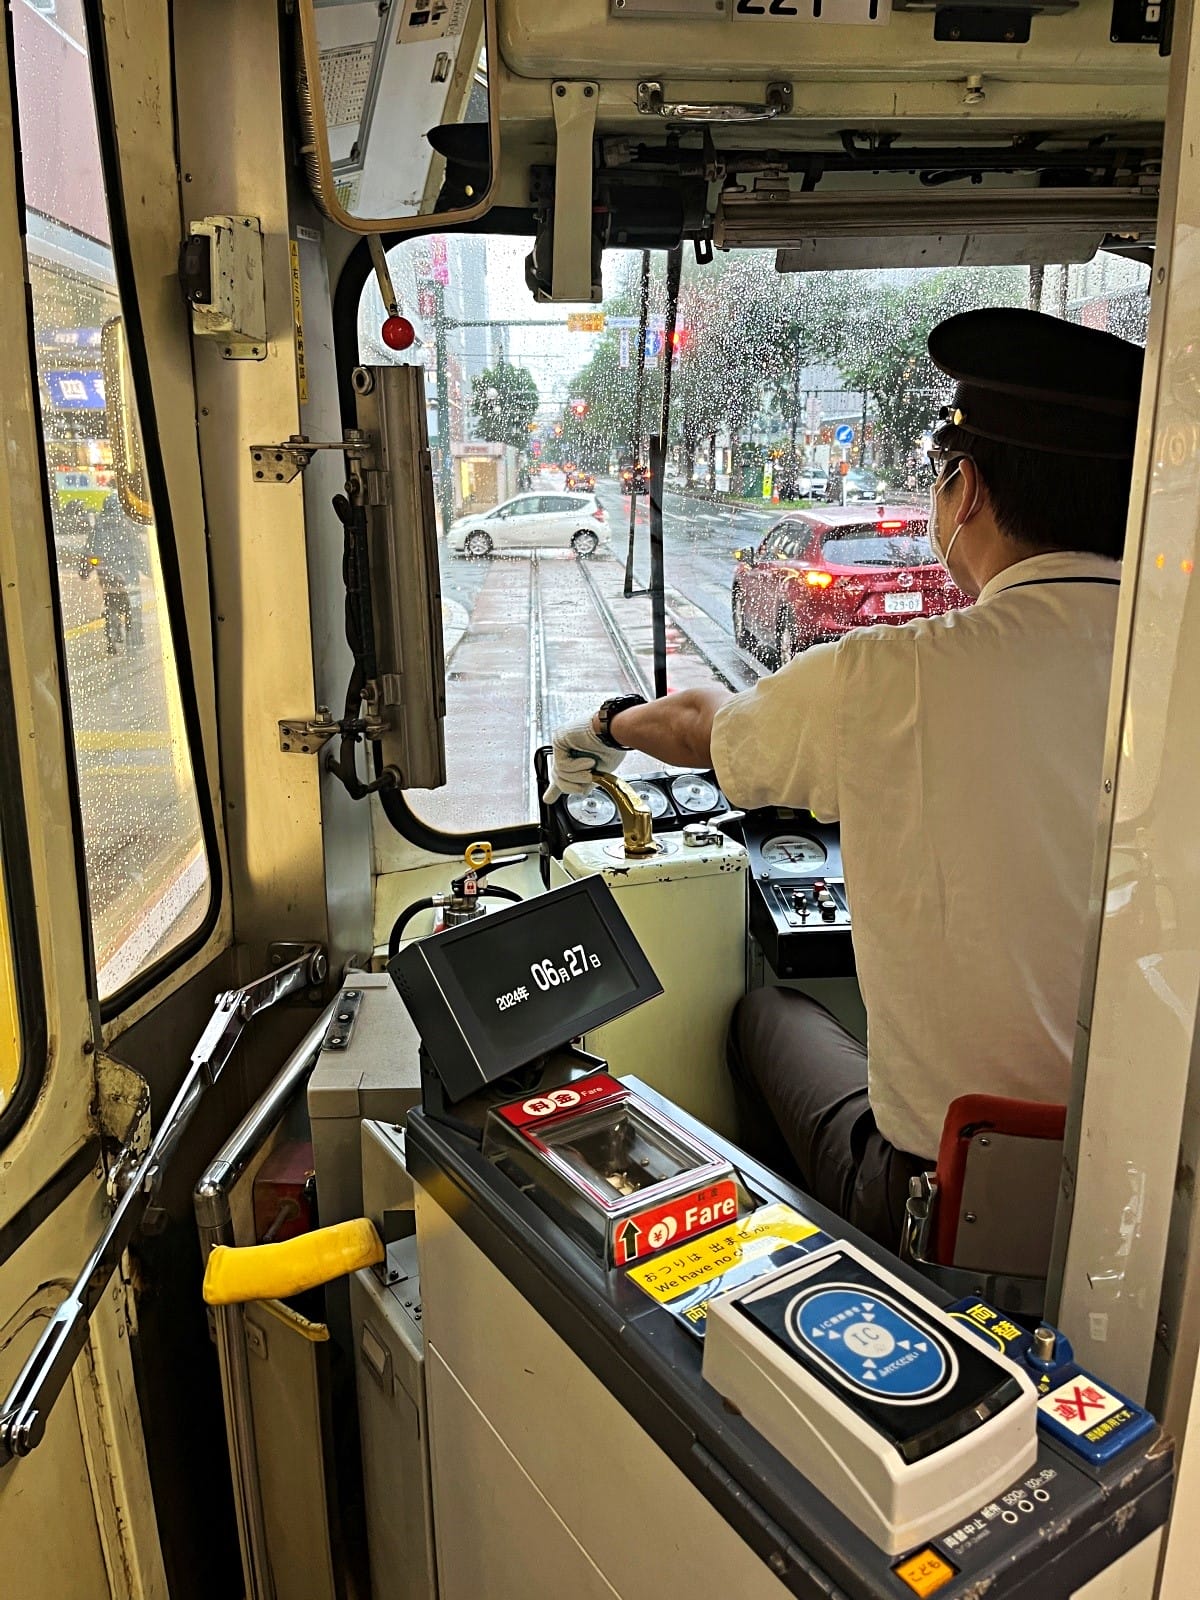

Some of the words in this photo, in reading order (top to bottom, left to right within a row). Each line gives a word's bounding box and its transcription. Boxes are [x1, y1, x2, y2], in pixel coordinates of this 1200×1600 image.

[495, 985, 530, 1011] 2024年
[530, 943, 602, 991] 06月27日
[528, 1090, 577, 1114] 料金
[580, 1085, 604, 1098] Fare
[685, 1198, 735, 1230] Fare
[643, 1250, 703, 1283] おつりは
[708, 1225, 771, 1253] 出ません。
[654, 1277, 679, 1294] We
[679, 1262, 713, 1286] have
[714, 1254, 733, 1267] no
[852, 1326, 880, 1347] IC
[964, 1302, 1024, 1342] 両替
[907, 1558, 942, 1582] こども
